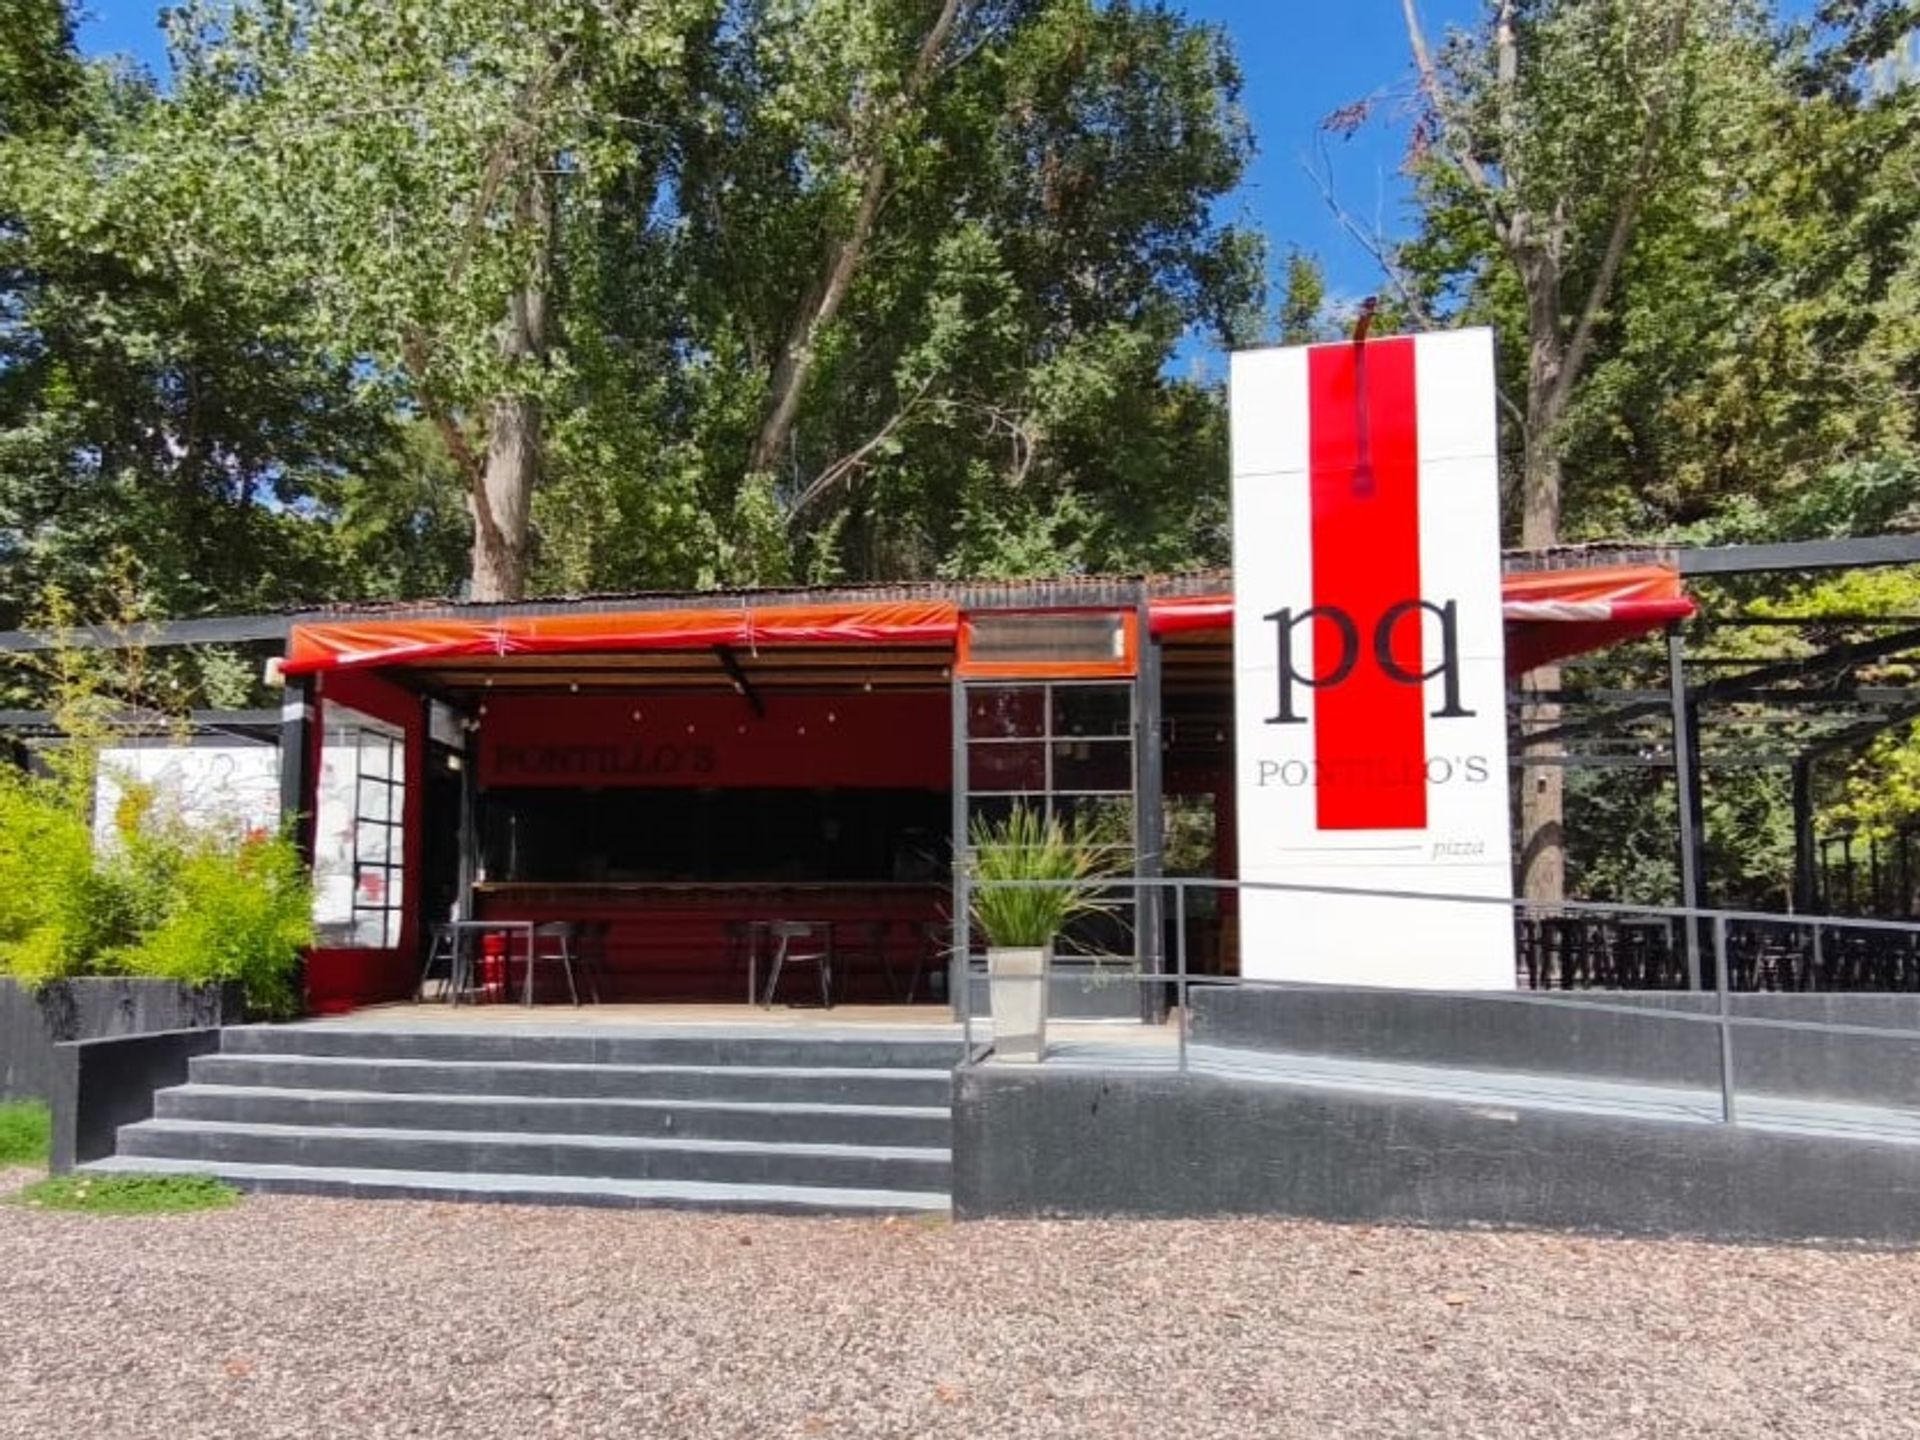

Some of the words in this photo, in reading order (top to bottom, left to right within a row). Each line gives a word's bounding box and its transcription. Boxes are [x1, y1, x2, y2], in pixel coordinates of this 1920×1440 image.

[1262, 598, 1477, 724] pq
[1257, 756, 1490, 787] PONTILLO'S
[1432, 838, 1486, 860] pizza
